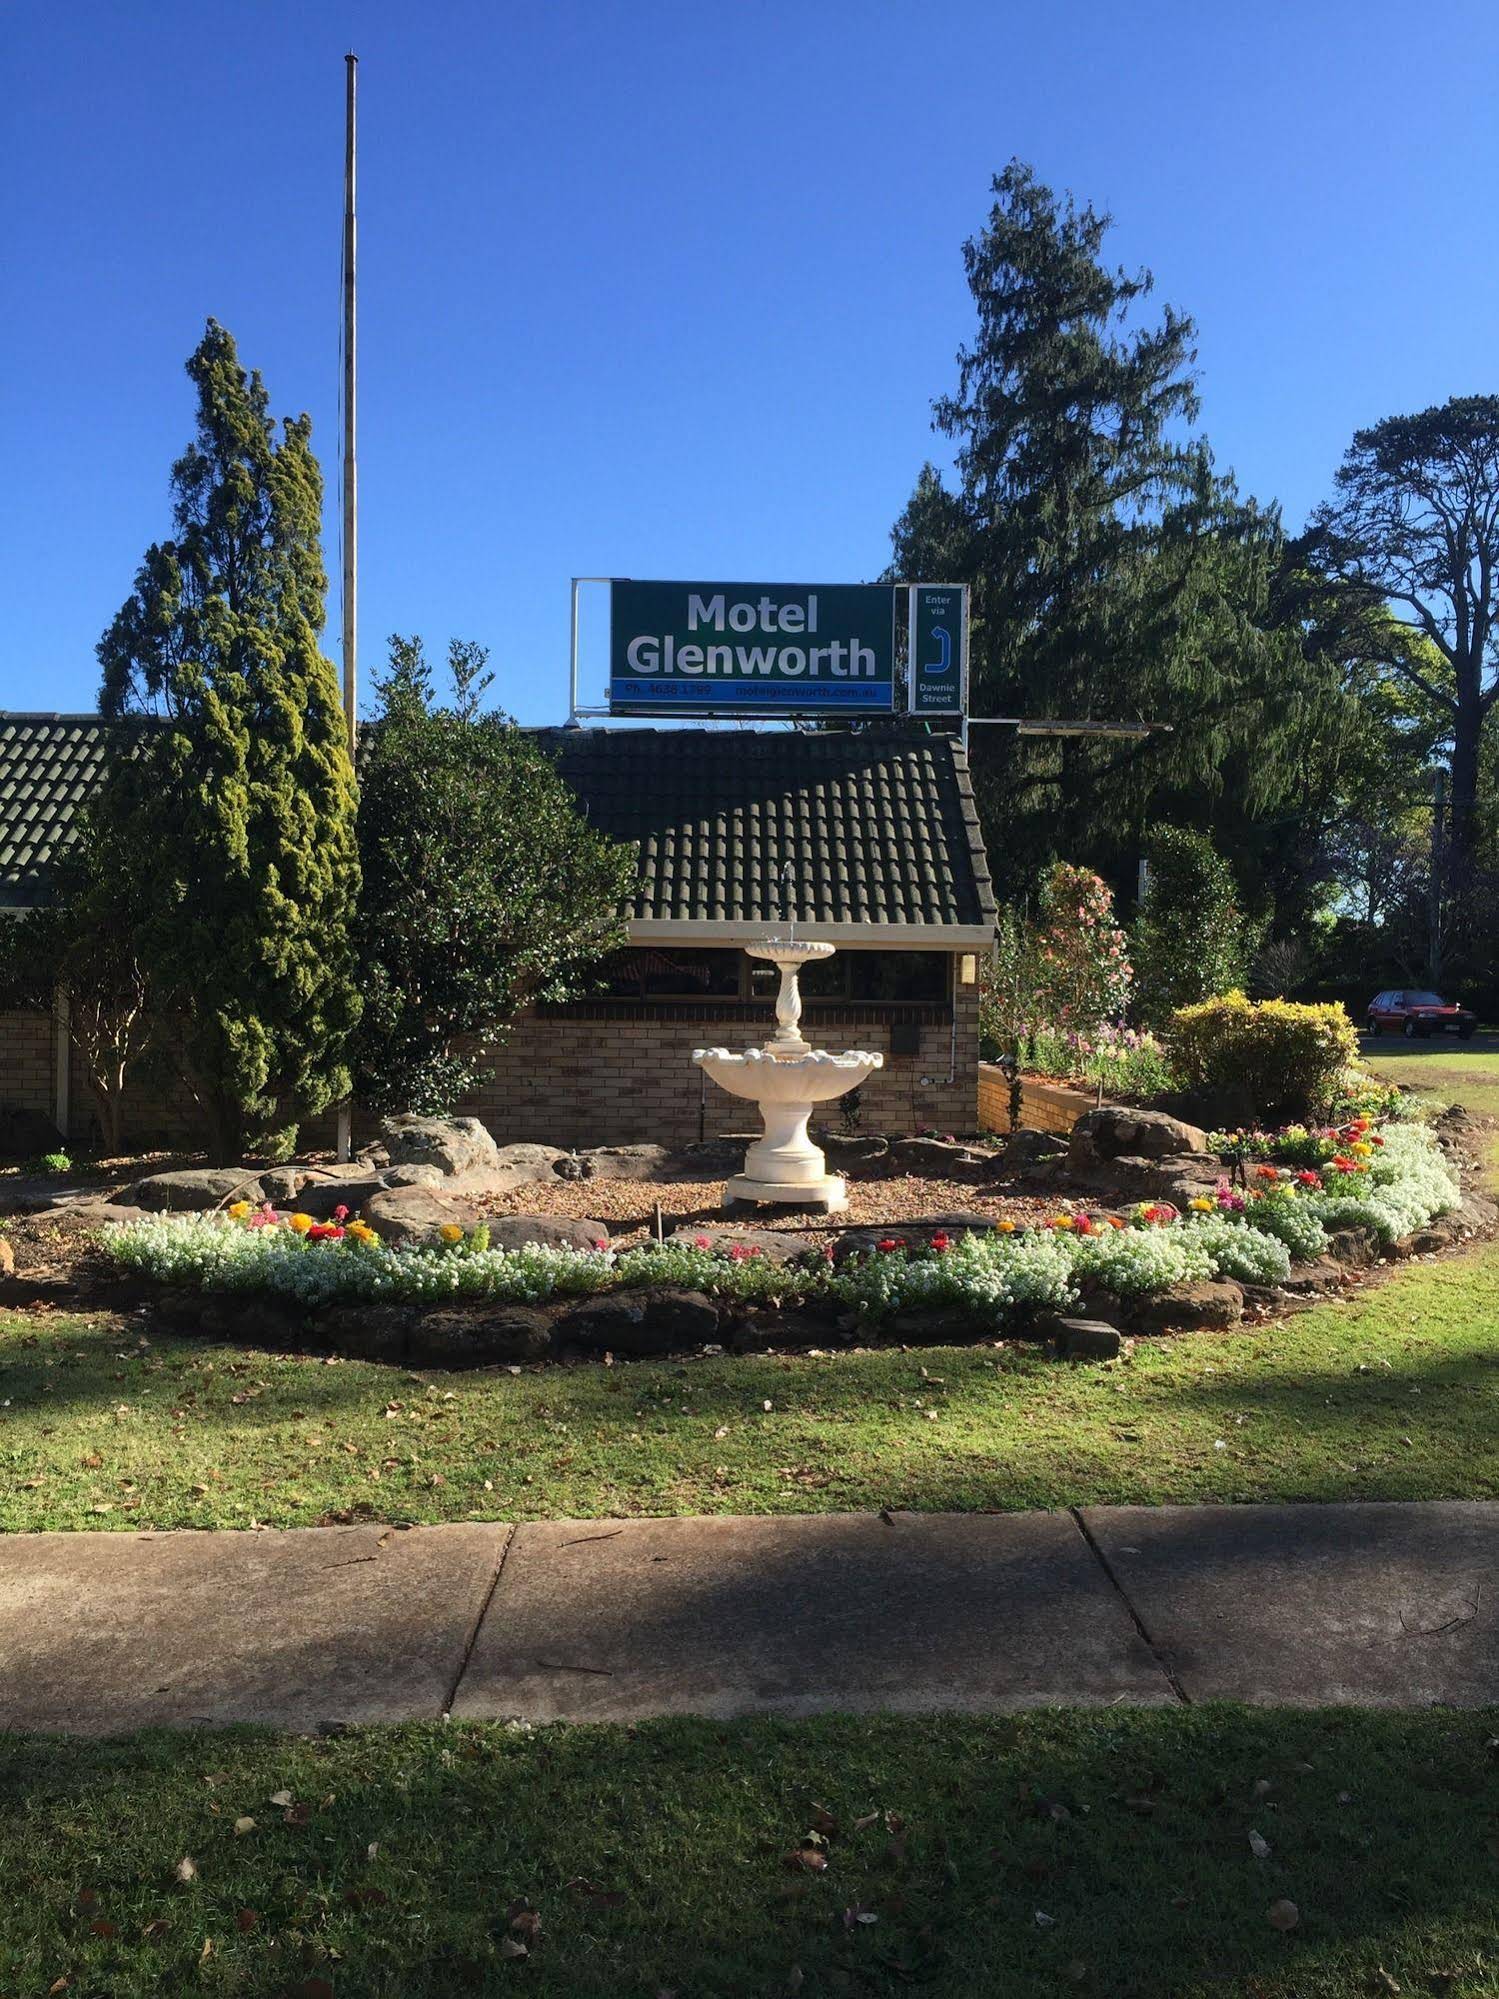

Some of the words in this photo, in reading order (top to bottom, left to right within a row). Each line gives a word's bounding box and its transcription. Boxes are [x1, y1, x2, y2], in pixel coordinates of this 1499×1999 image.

[925, 595, 951, 605] Enter
[687, 594, 817, 633] Motel
[931, 607, 945, 615] via
[626, 635, 876, 676] Glenworth
[922, 694, 952, 703] Street
